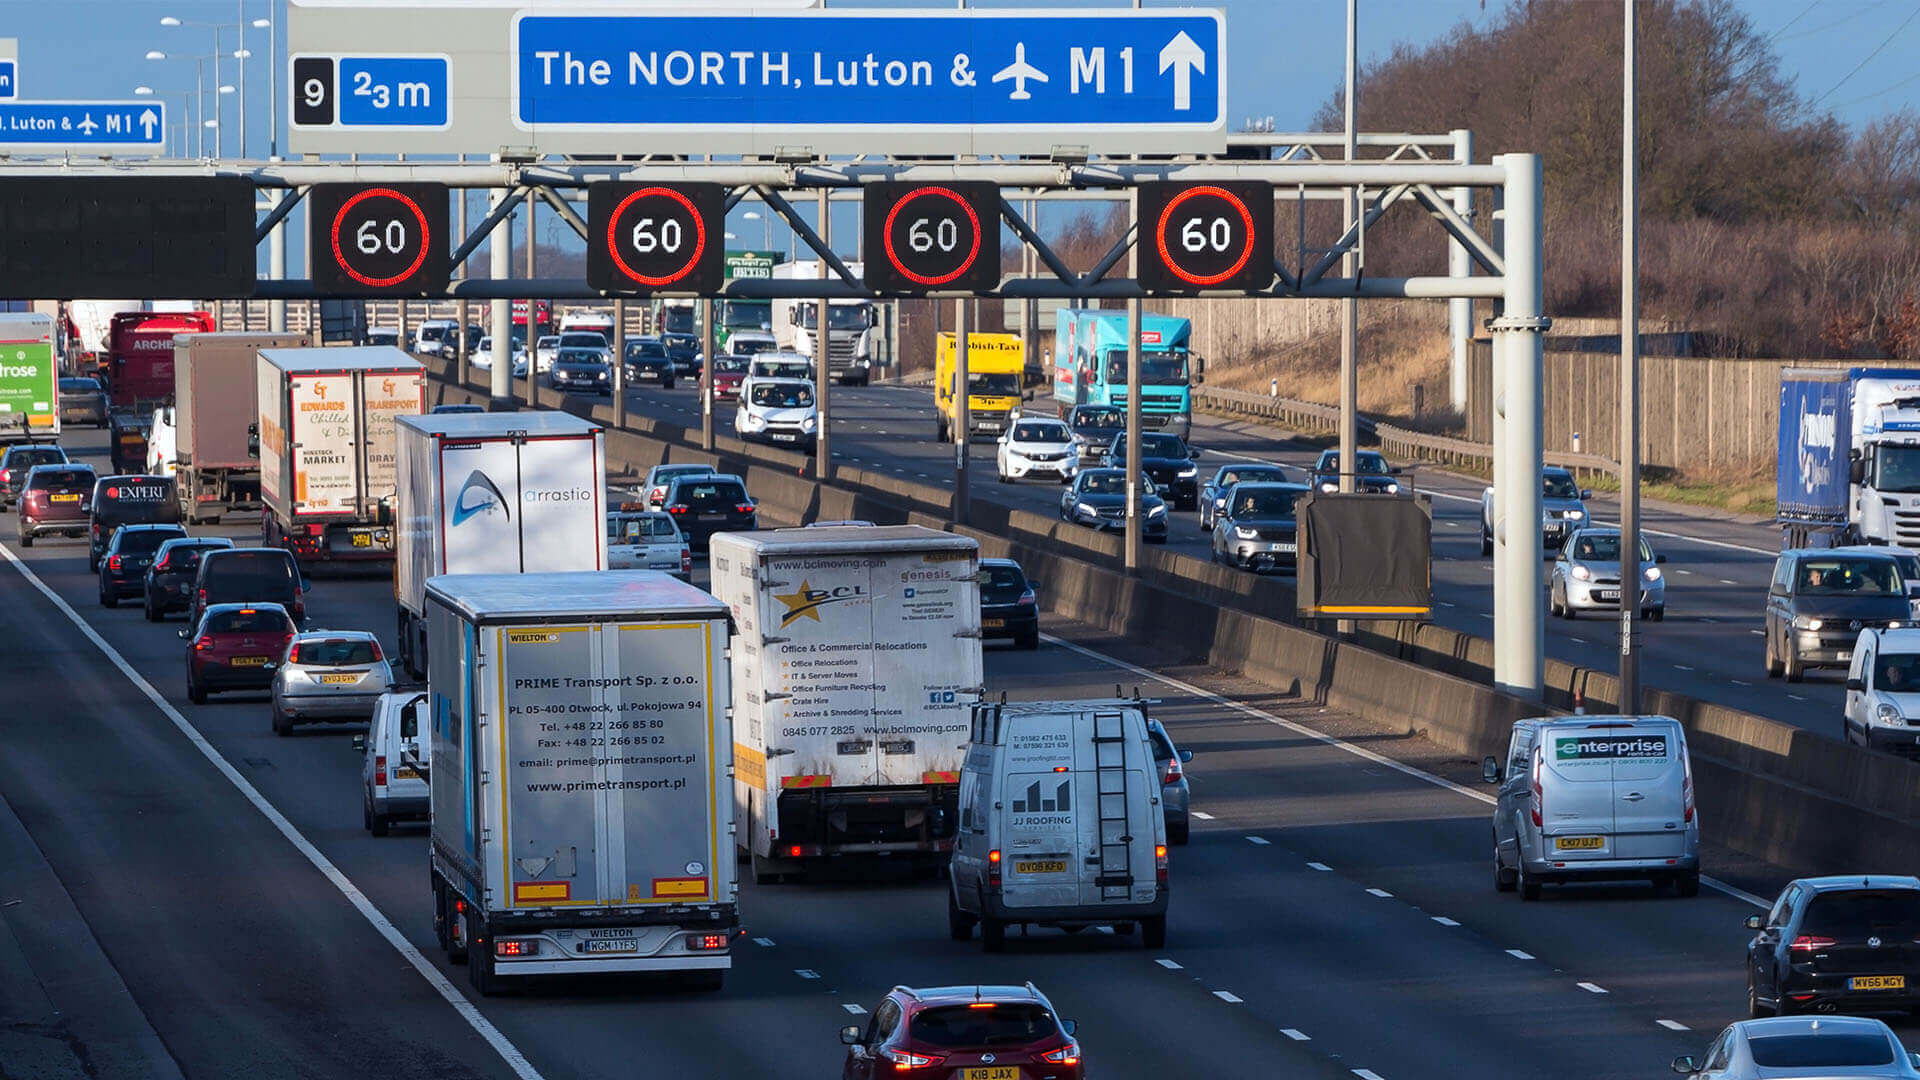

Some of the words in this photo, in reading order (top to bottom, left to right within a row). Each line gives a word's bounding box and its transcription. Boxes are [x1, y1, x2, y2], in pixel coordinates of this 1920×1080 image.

[535, 50, 611, 86] The
[628, 49, 803, 89] NORTH,
[812, 51, 933, 87] Luton
[949, 52, 977, 87] &
[1069, 46, 1134, 95] M1
[303, 77, 325, 108] 9
[11, 115, 56, 131] Luton
[61, 116, 72, 131] &
[106, 114, 132, 134] M1
[356, 219, 406, 255] 60
[632, 218, 682, 254] 60
[908, 218, 958, 254] 60
[1180, 217, 1231, 253] 60
[133, 339, 175, 351] ARCHE
[949, 340, 1020, 351] Rbish-Taxi
[300, 401, 345, 412] EDWARDS
[366, 400, 418, 410] TRANSPORT
[310, 412, 350, 424] Chilled
[304, 455, 346, 465] MARKET
[369, 453, 395, 463] DRAY
[119, 486, 164, 498] EXPERT
[525, 487, 591, 502] arrastio
[773, 558, 887, 571] www.bclmoving.com
[900, 569, 952, 583] genesis
[803, 585, 868, 602] BCL
[510, 633, 547, 642] WIELTON
[781, 644, 808, 654] Office
[809, 644, 817, 653] &
[818, 642, 872, 653] Commercial
[874, 641, 928, 652] Relocations
[790, 660, 813, 668] Office
[814, 658, 858, 667] Relocations
[808, 672, 832, 680] Server
[834, 671, 858, 679] Moves
[515, 678, 559, 689] PRIME
[563, 676, 631, 690] Transport
[636, 676, 657, 689] Sp.
[662, 677, 669, 685] z
[673, 676, 698, 685] o.o.
[792, 685, 814, 693] Office
[815, 684, 848, 692] Furniture
[850, 683, 887, 692] Recycling
[792, 697, 812, 705] Crate
[814, 696, 829, 704] Hire
[509, 706, 523, 714] PL
[526, 704, 565, 714] 05-400
[569, 703, 613, 714] Otwock,
[632, 701, 685, 712] Pokojowa
[688, 701, 701, 710] 94
[793, 710, 821, 718] Archive
[830, 708, 869, 717] Shredding
[870, 707, 902, 716] Services
[540, 723, 560, 732] Tel.
[564, 722, 586, 731] +48
[589, 722, 603, 730] 22
[609, 721, 629, 730] 266
[632, 720, 646, 729] 85
[650, 720, 664, 729] 80
[782, 727, 807, 737] 0845
[809, 726, 828, 736] 077
[830, 725, 855, 735] 2825
[864, 723, 968, 736] www.bclmoving.com
[538, 739, 561, 748] Fax:
[565, 738, 587, 747] +48
[590, 738, 604, 746] 22
[610, 737, 631, 746] 266
[633, 736, 648, 745] 85
[651, 736, 665, 745] 02
[1557, 738, 1665, 756] enterprise
[519, 758, 553, 768] email:
[556, 754, 696, 769] prime@primetransport.pl
[527, 778, 686, 793] www.primetransport.pl
[1014, 817, 1024, 825] JJ
[1026, 816, 1072, 825] ROOFING
[590, 929, 632, 937] WIELTON
[591, 941, 612, 950] WGM
[991, 1068, 1013, 1080] JAX
